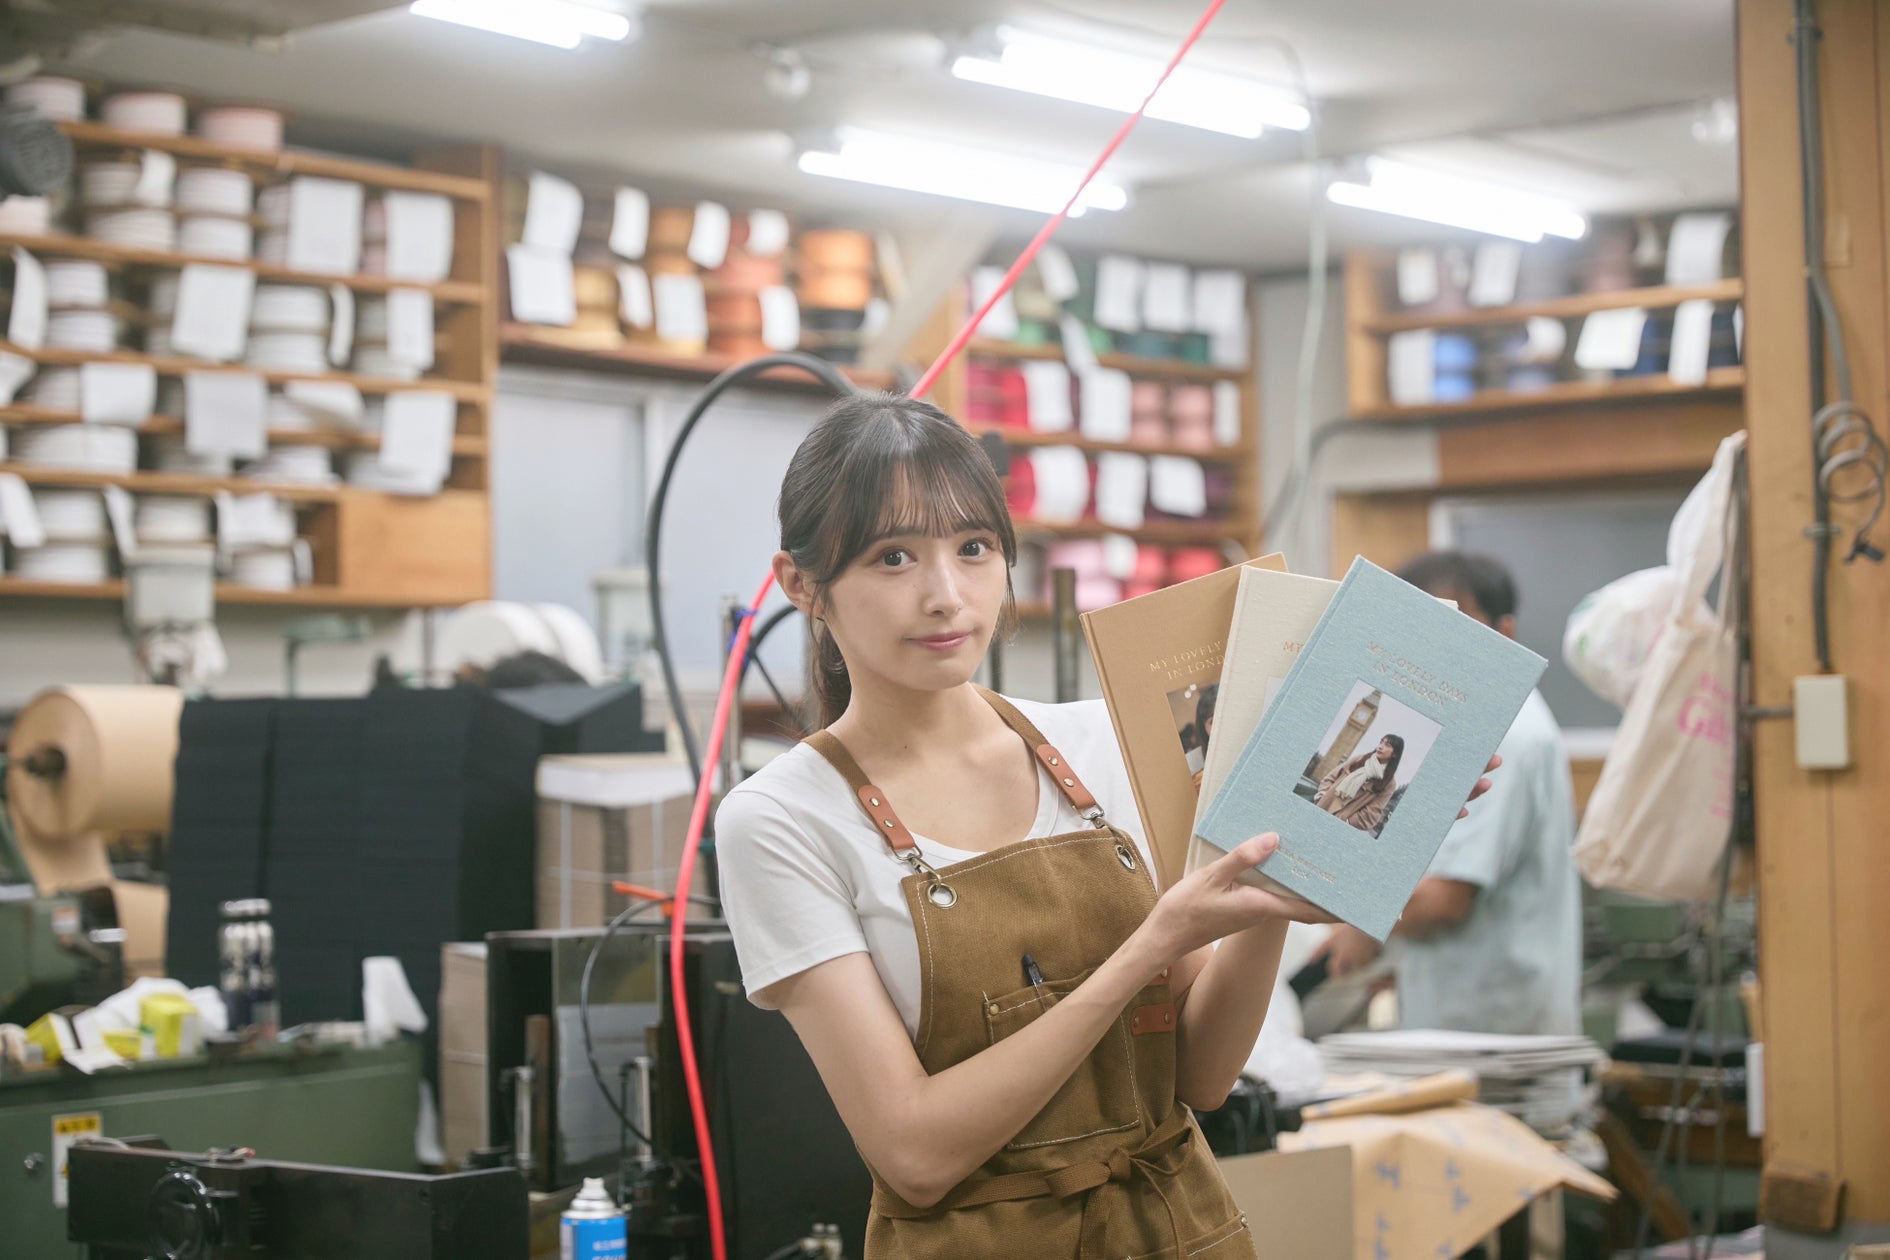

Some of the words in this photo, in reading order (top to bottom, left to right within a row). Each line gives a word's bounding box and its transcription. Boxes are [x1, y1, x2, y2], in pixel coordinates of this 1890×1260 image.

[1150, 658, 1169, 672] MY
[1174, 641, 1221, 664] LOVELY
[1167, 667, 1183, 680] IN
[1388, 653, 1436, 684] LOVELY
[1439, 681, 1469, 704] DAYS
[1391, 671, 1445, 706] LONDON
